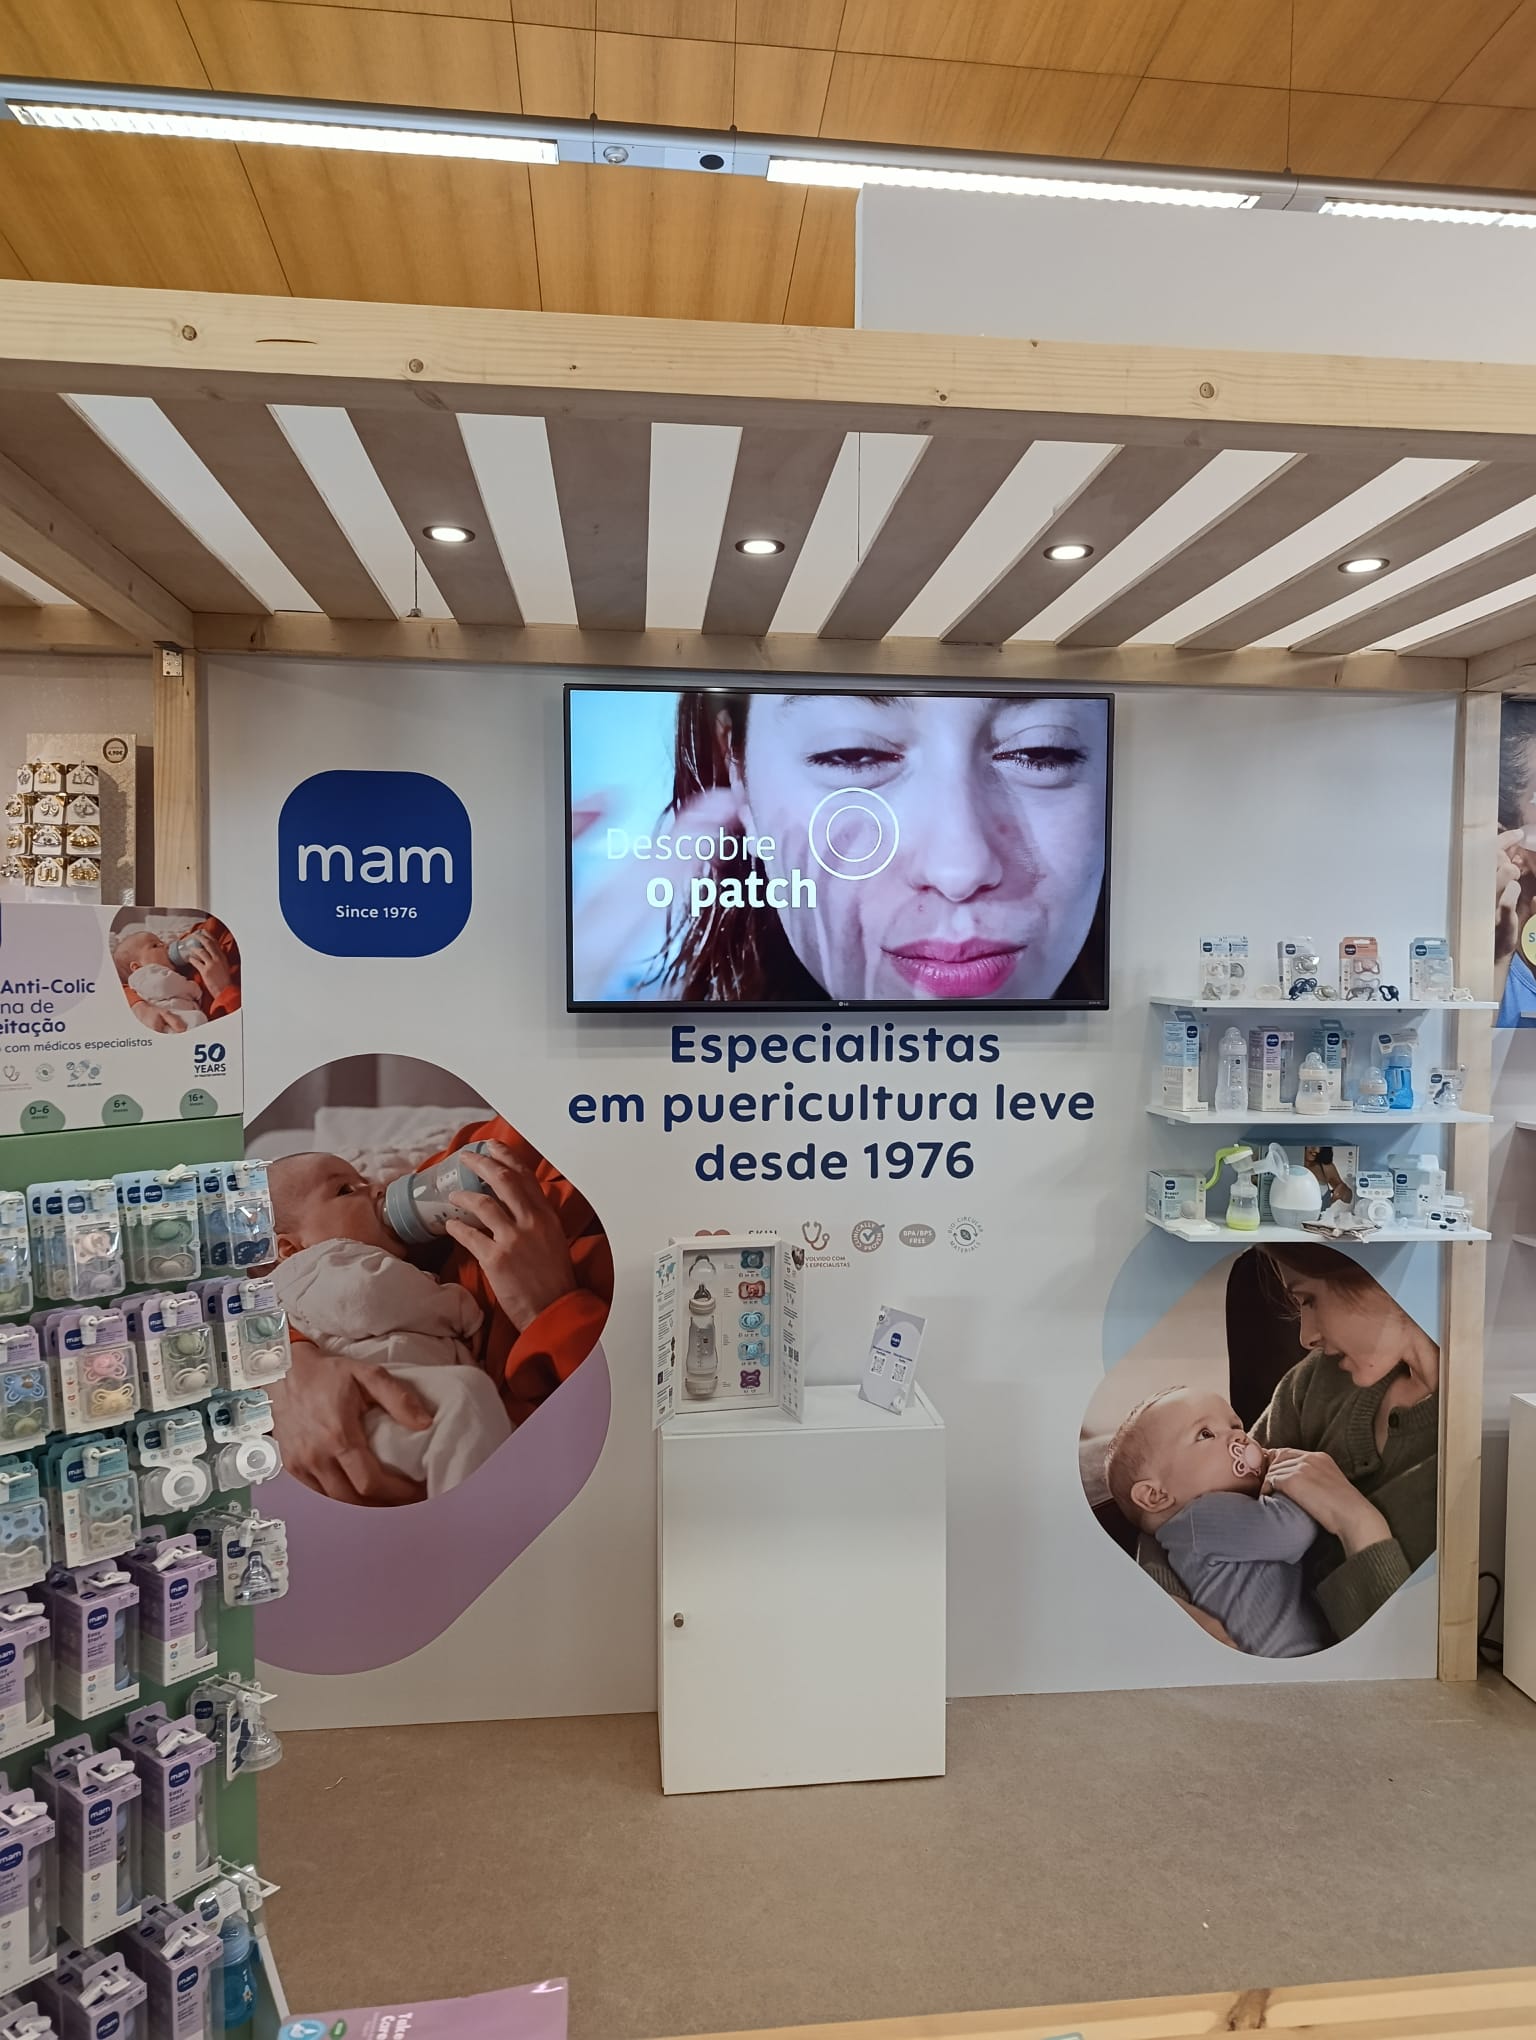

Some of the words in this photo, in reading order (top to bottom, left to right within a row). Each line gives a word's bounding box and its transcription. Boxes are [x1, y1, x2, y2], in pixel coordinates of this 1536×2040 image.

[606, 827, 776, 861] Descobre
[298, 844, 453, 884] mam
[646, 875, 674, 908] o
[690, 868, 817, 917] patch
[335, 905, 379, 918] Since
[383, 906, 418, 919] 1976
[0, 978, 96, 995] Anti-Colic
[30, 1000, 54, 1014] de
[0, 1018, 66, 1037] itação
[4, 1044, 30, 1053] com
[33, 1040, 82, 1051] médicos
[84, 1037, 153, 1051] especialistas
[670, 1022, 1000, 1073] Especialistas
[194, 1043, 226, 1064] 50
[194, 1063, 226, 1074] YEARS
[113, 1099, 126, 1108] 6+
[188, 1094, 204, 1102] 16+
[29, 1105, 50, 1115] 0-6
[567, 1091, 645, 1124] em
[663, 1082, 978, 1132] puericultura
[995, 1084, 1095, 1121] leve
[695, 1143, 848, 1181] desde
[863, 1141, 974, 1180] 1976
[170, 1769, 189, 1780] mam
[90, 1806, 111, 1819] mam
